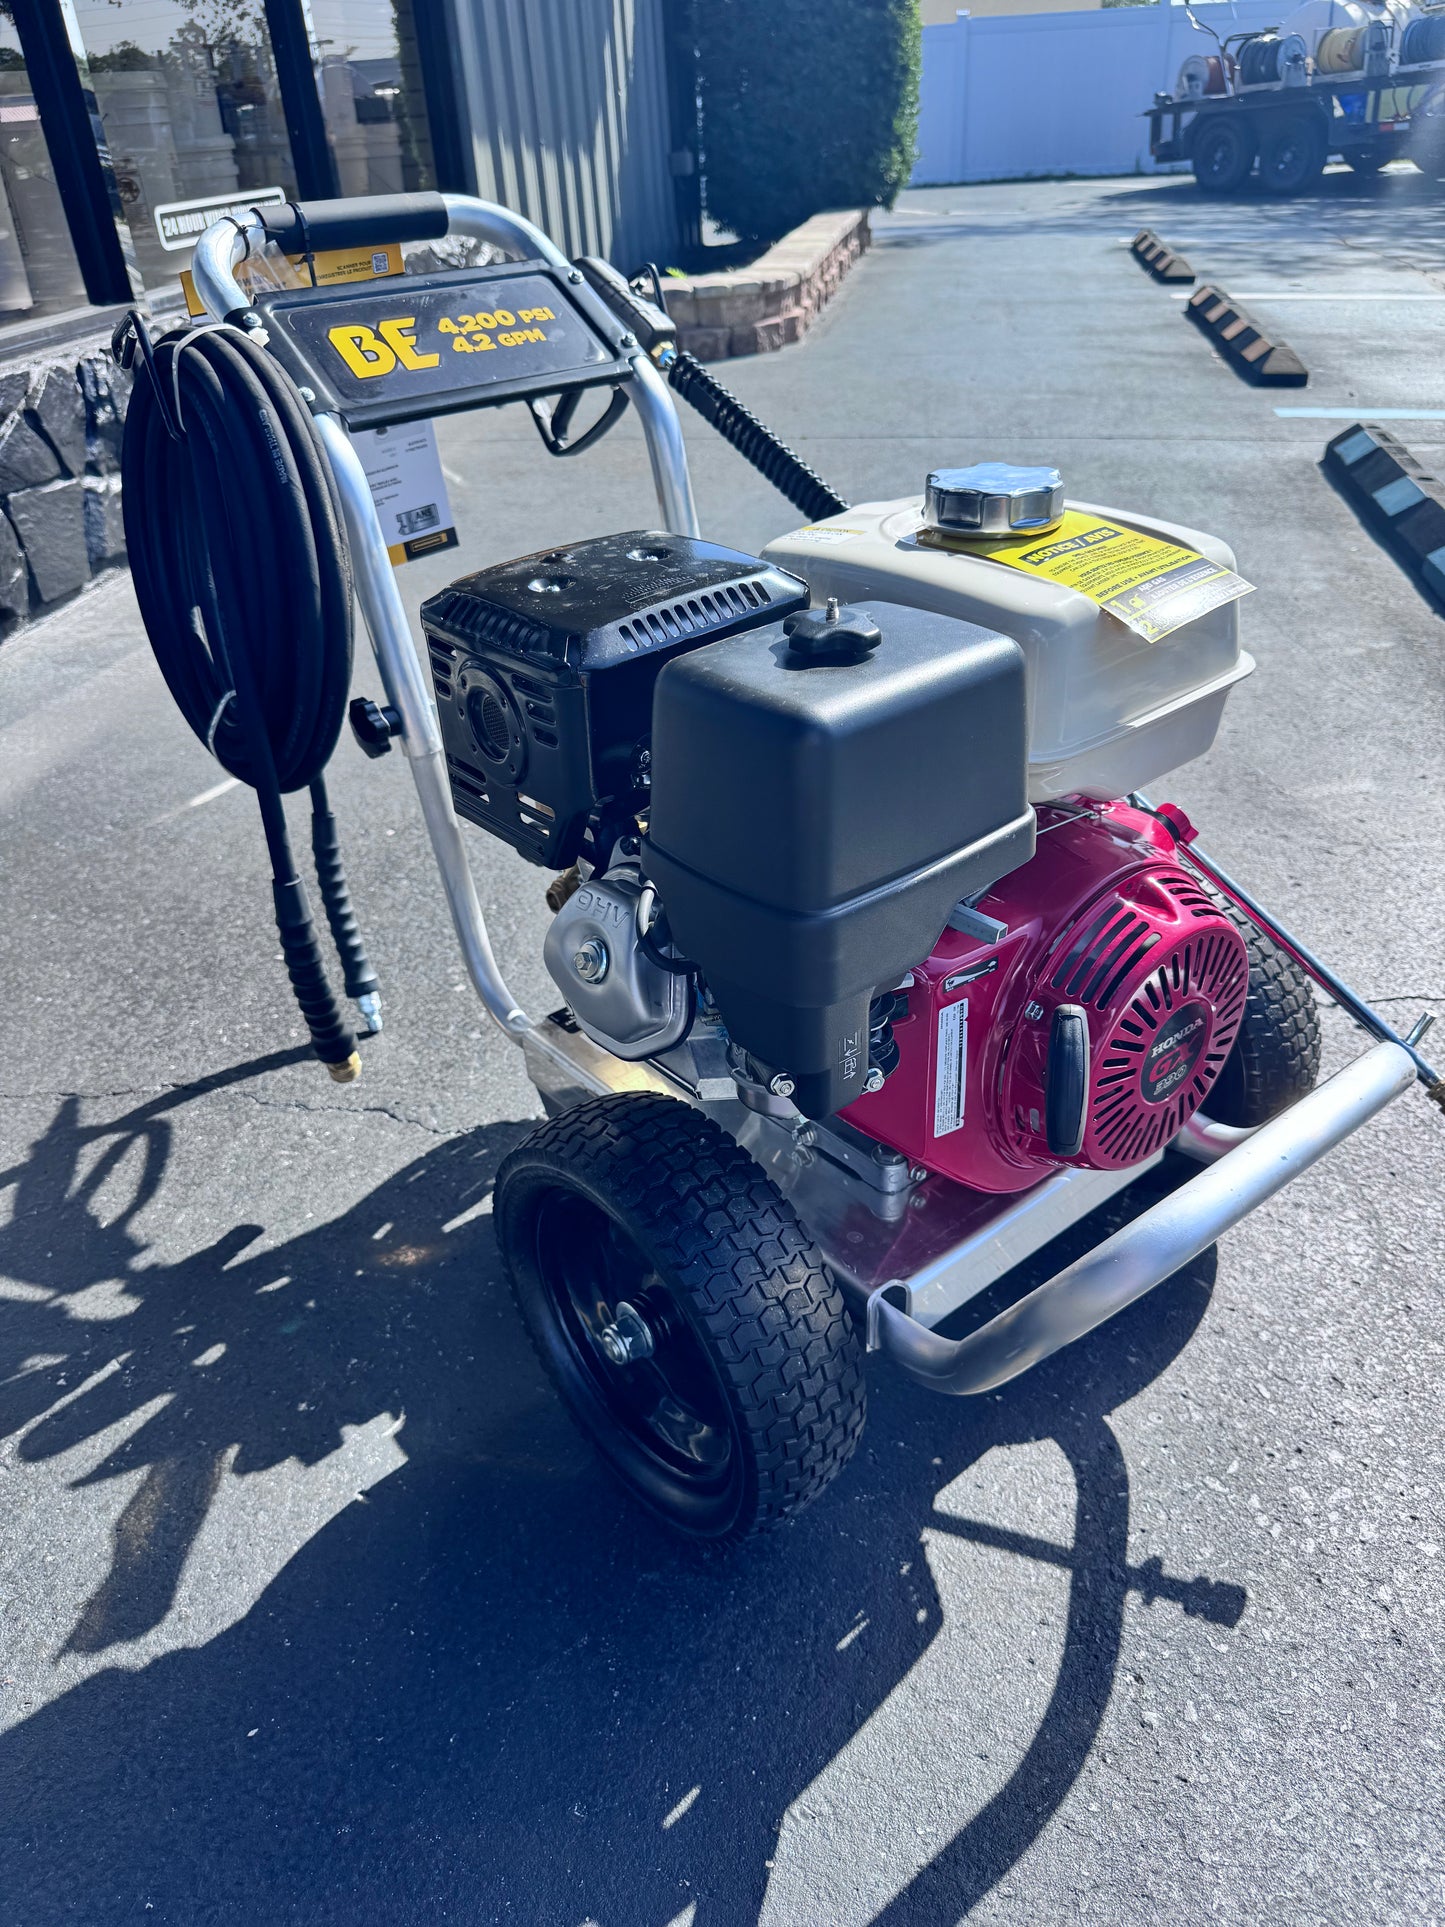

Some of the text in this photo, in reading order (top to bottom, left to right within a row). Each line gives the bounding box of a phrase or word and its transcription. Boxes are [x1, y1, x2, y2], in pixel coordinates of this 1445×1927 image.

[162, 216, 180, 237] 24
[176, 212, 206, 234] HOUR
[336, 262, 358, 271] SCANNER
[438, 307, 556, 335] 4,200 PSI
[328, 317, 440, 379] BE
[452, 327, 547, 353] 4.2 GPM
[1026, 541, 1079, 563] NOTICE
[1083, 529, 1116, 543] AVIS
[1095, 583, 1123, 598] BEFORE
[1120, 577, 1136, 585] USE
[1138, 567, 1159, 578] AVANT
[1157, 555, 1192, 570] UTILISATION
[1137, 576, 1167, 592] ADD GAS
[1109, 600, 1132, 614] 1
[1140, 620, 1159, 635] 2
[575, 889, 631, 929] OHV
[1151, 1017, 1204, 1058] HONDA
[1149, 1039, 1195, 1083] GX
